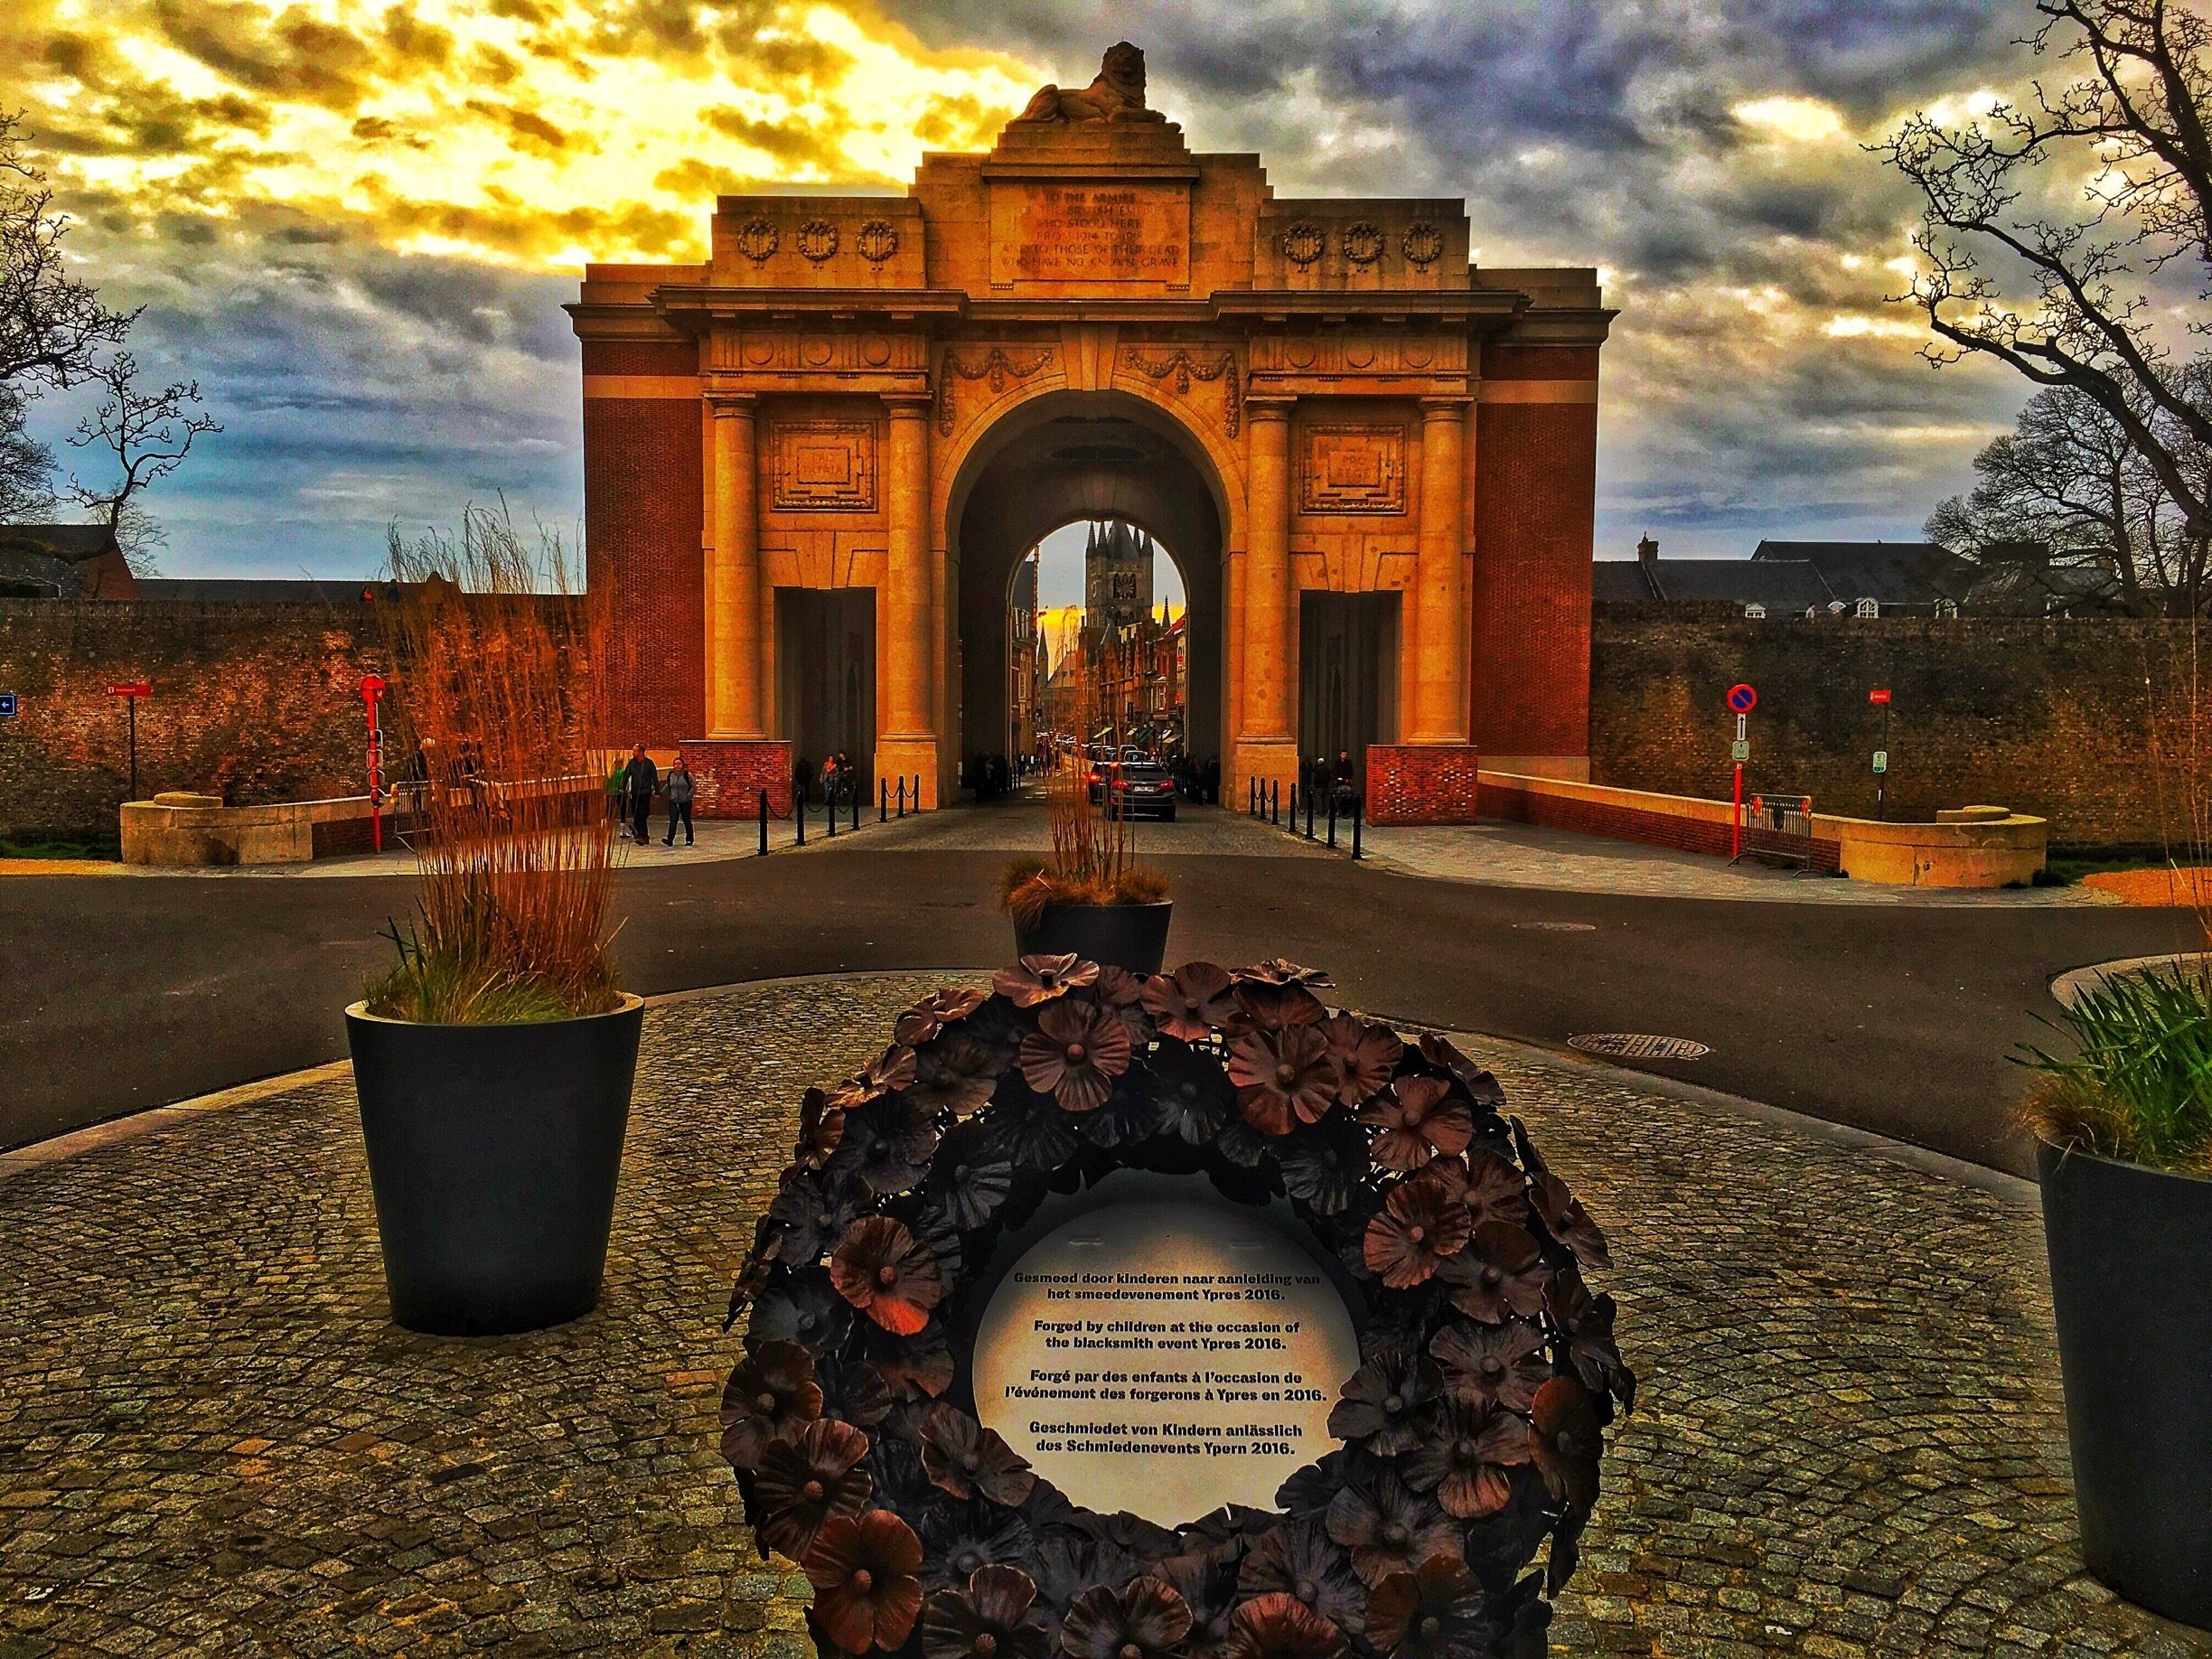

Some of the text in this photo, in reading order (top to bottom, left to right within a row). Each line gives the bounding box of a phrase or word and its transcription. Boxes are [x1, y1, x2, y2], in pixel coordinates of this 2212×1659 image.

[1064, 193, 1085, 203] THE
[1092, 193, 1136, 203] ARMIES
[1036, 219, 1142, 228] WHO STOOD HERE
[1076, 232, 1099, 241] 1914
[1104, 232, 1118, 241] TO
[1002, 244, 1029, 254] AD
[1034, 244, 1047, 254] TO
[1054, 244, 1089, 254] THOSE
[1094, 244, 1107, 254] OF
[1149, 244, 1179, 254] DEAD
[1033, 258, 1061, 267] HAVE
[1067, 258, 1084, 267] NO
[1141, 258, 1179, 267] GRAVE
[1014, 1272, 1320, 1286] Gesmeed door kinderen naar aanleiding van
[1047, 1289, 1285, 1302] het smeedevenement Ypres 2016.
[1035, 1320, 1299, 1334] Forged by children at the occasion of
[1045, 1336, 1286, 1351] the blacksmith event Ypres 2016.
[1030, 1370, 1071, 1383] Forgé
[1074, 1372, 1100, 1383] par
[1102, 1371, 1128, 1382] des
[1132, 1371, 1187, 1382] enfants
[1192, 1372, 1201, 1382] à
[1284, 1372, 1302, 1383] de
[1100, 1388, 1125, 1400] des
[1129, 1388, 1200, 1402] forgerons
[1204, 1389, 1214, 1401] à
[1217, 1389, 1257, 1402] Ypres
[1261, 1392, 1279, 1401] en
[1284, 1389, 1326, 1401] 2016.
[1030, 1420, 1302, 1436] Geschmiedet von Kindern anlässlich
[1036, 1439, 1295, 1457] des Schmiedenevents Ypern 2016.
